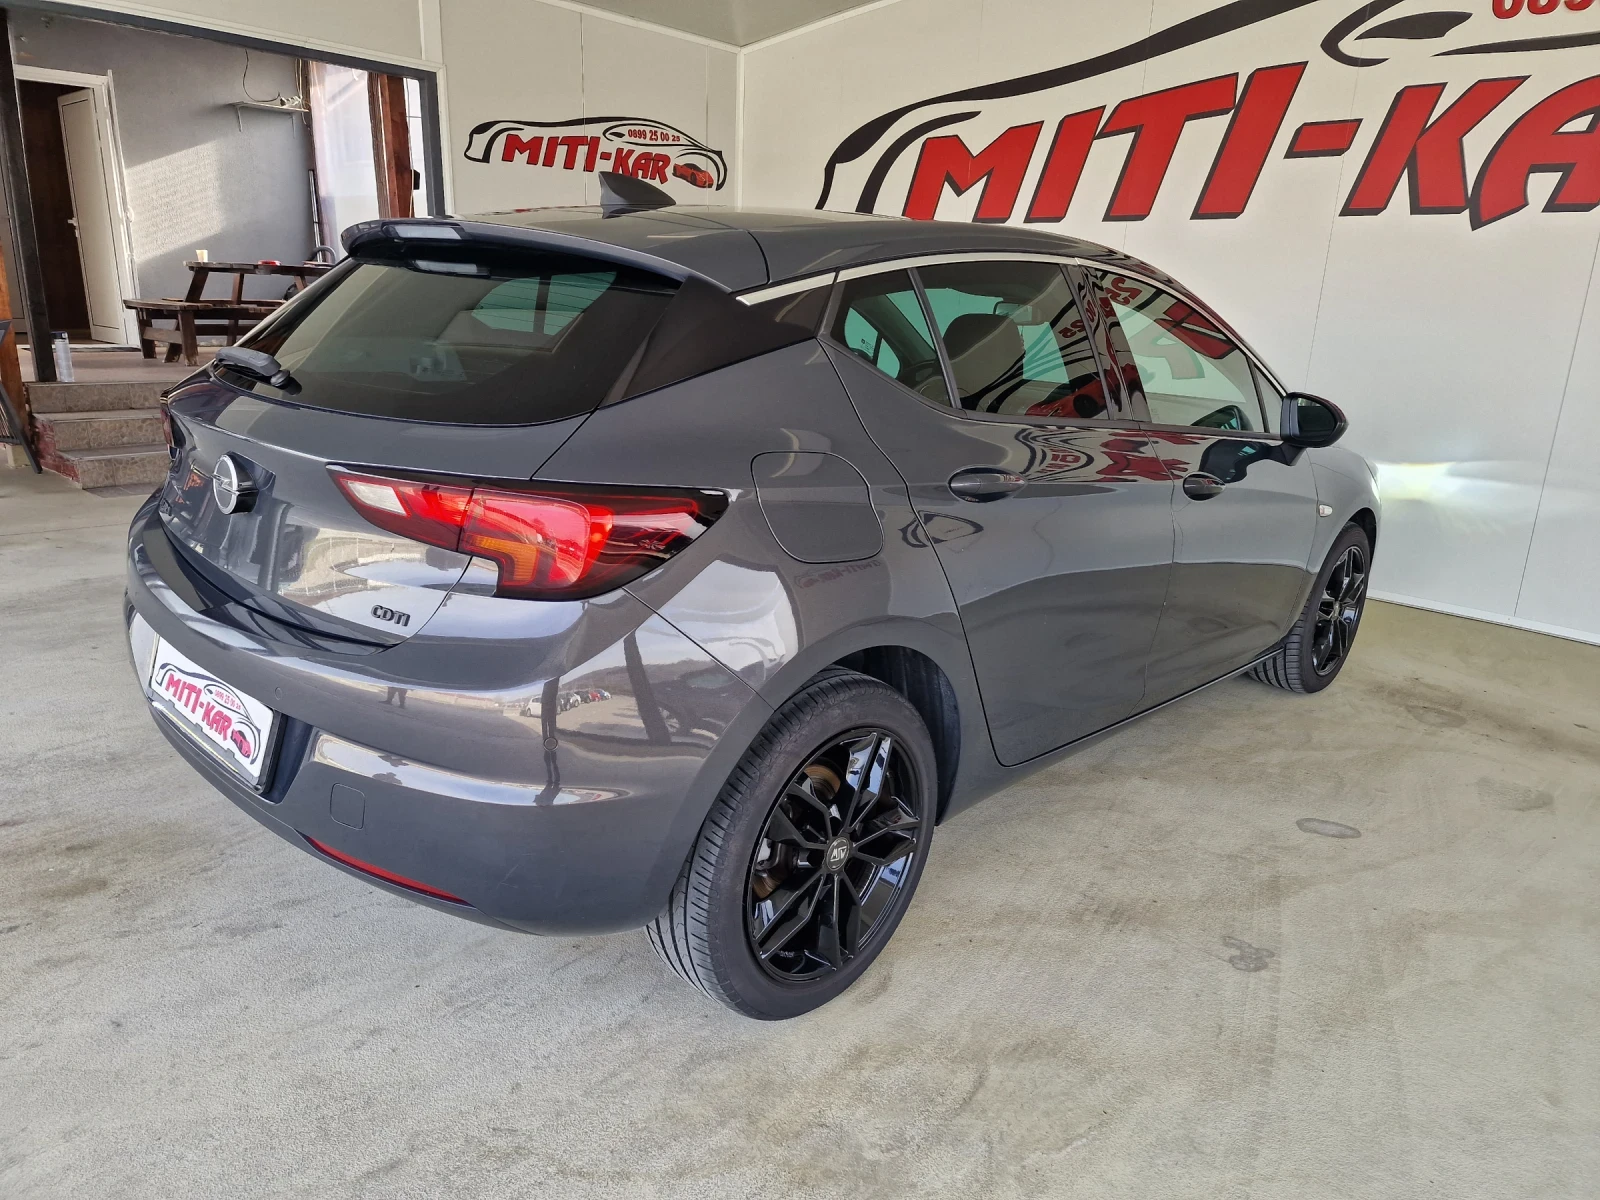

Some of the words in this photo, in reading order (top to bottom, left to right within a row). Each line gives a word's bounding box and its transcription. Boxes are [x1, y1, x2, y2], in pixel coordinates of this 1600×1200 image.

[627, 128, 647, 140] 0899
[649, 130, 659, 142] 25
[660, 131, 670, 142] 00
[671, 134, 681, 142] 25
[501, 133, 671, 185] MITI-KAR
[371, 604, 411, 627] CDTI
[165, 673, 232, 741] MITI-KAR
